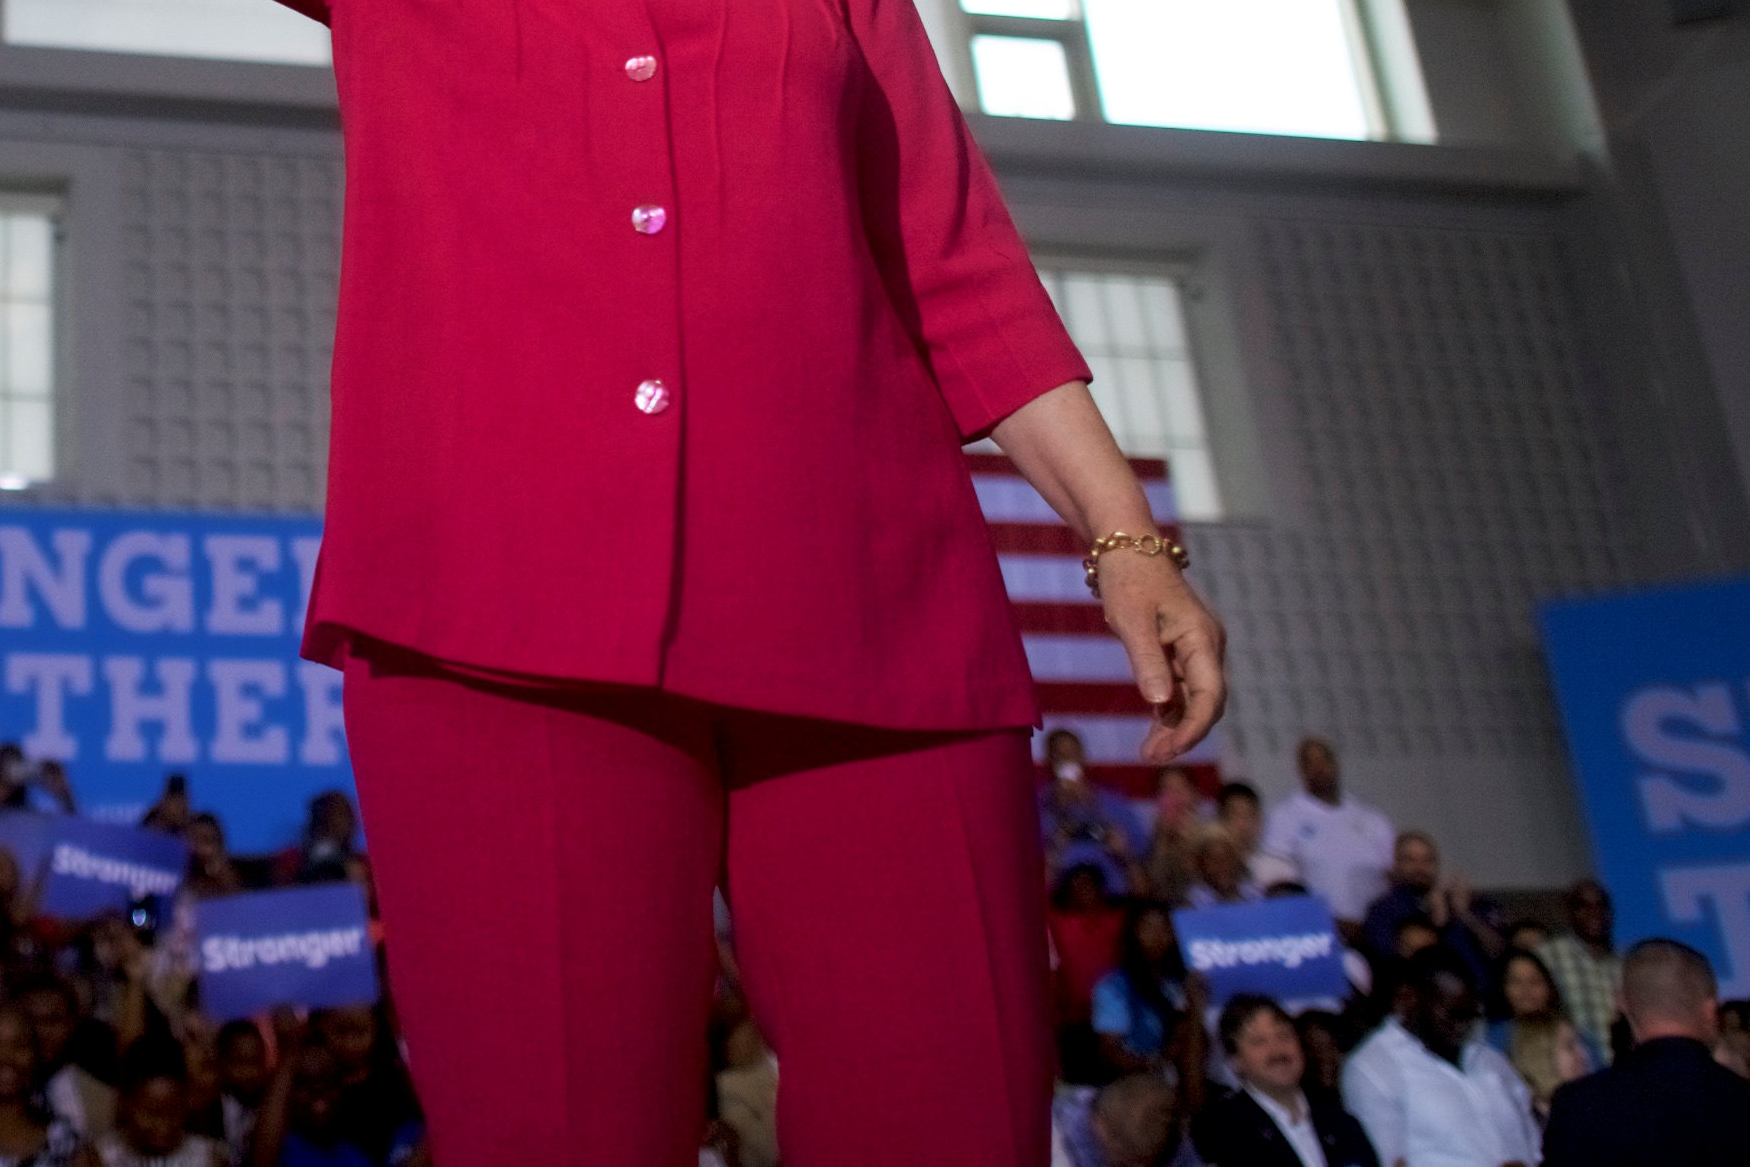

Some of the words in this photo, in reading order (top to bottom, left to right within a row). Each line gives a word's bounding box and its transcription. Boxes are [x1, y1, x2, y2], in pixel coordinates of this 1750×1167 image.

[52, 844, 180, 896] Stronger
[202, 926, 363, 972] Stronger
[1189, 931, 1333, 971] Stronger
